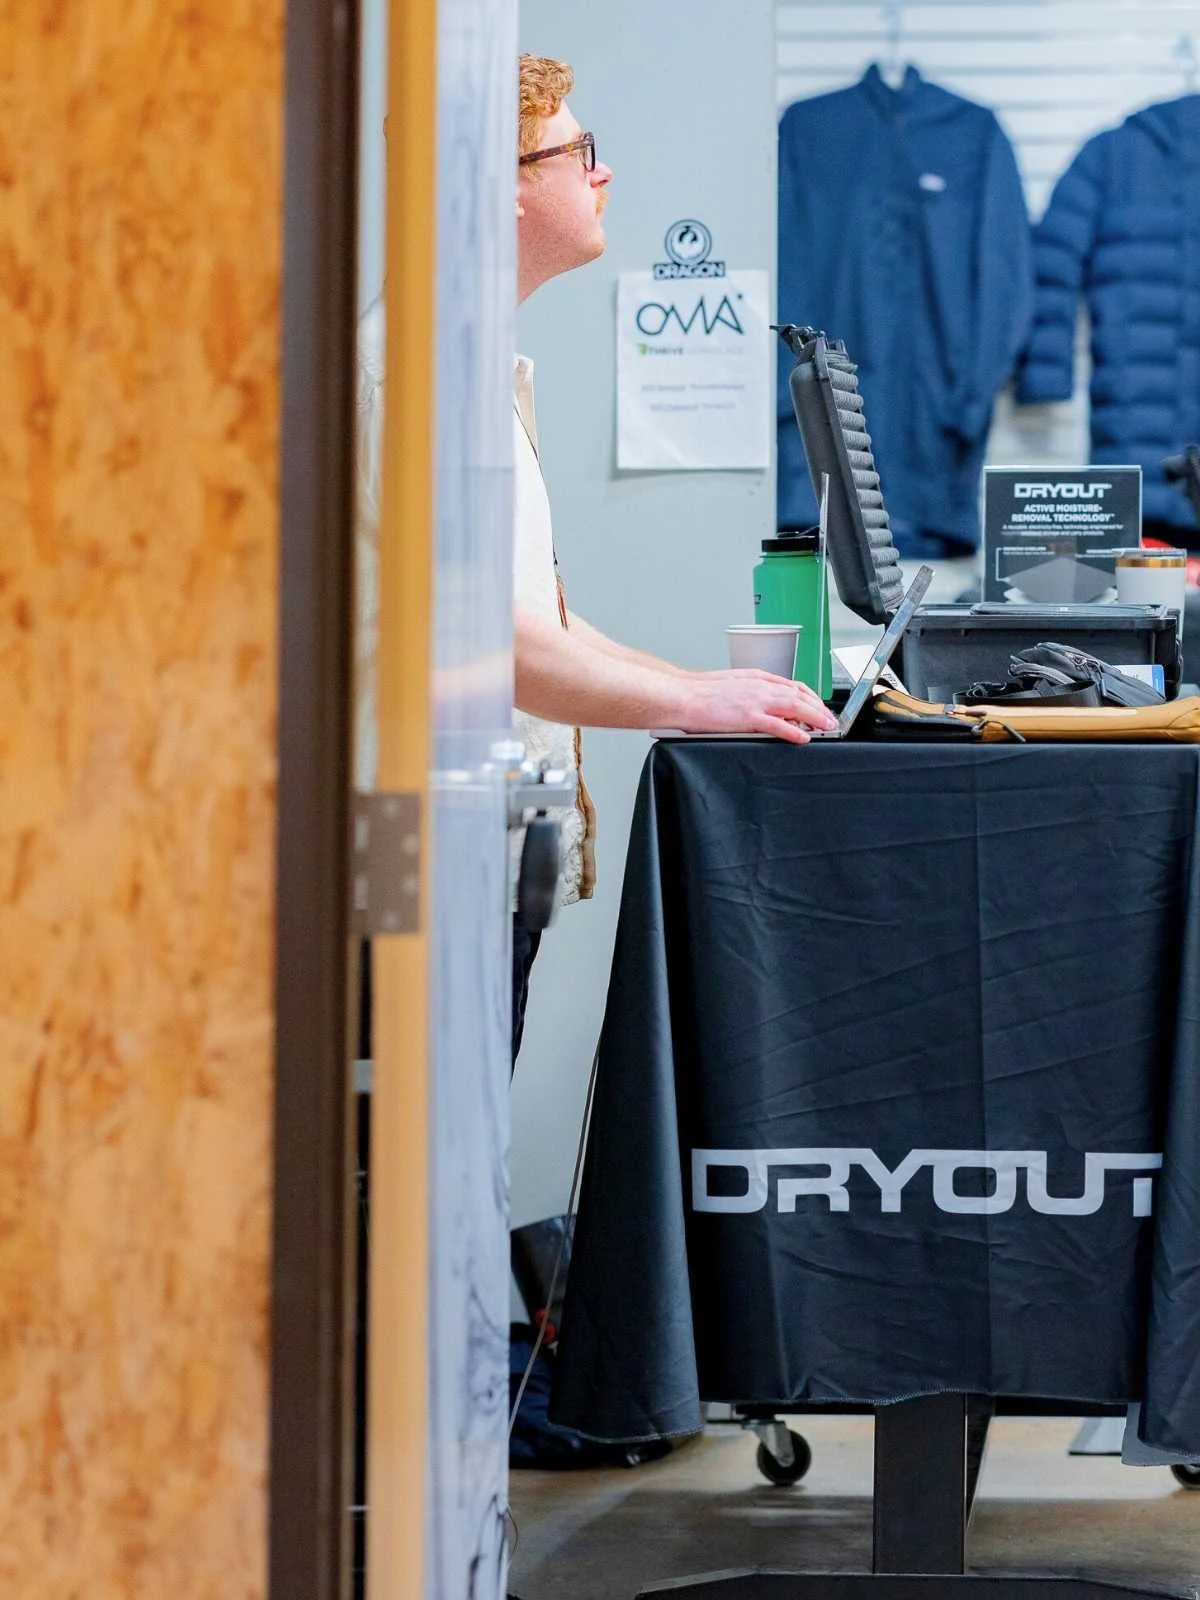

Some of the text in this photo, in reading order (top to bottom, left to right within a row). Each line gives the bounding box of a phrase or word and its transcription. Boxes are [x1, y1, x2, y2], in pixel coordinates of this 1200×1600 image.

[655, 262, 724, 279] DRAGON
[1014, 483, 1112, 498] DRYOUT
[1023, 504, 1054, 513] ACTIVE
[1011, 513, 1052, 522] REMOVAL
[691, 1148, 1162, 1218] DRYOUT
